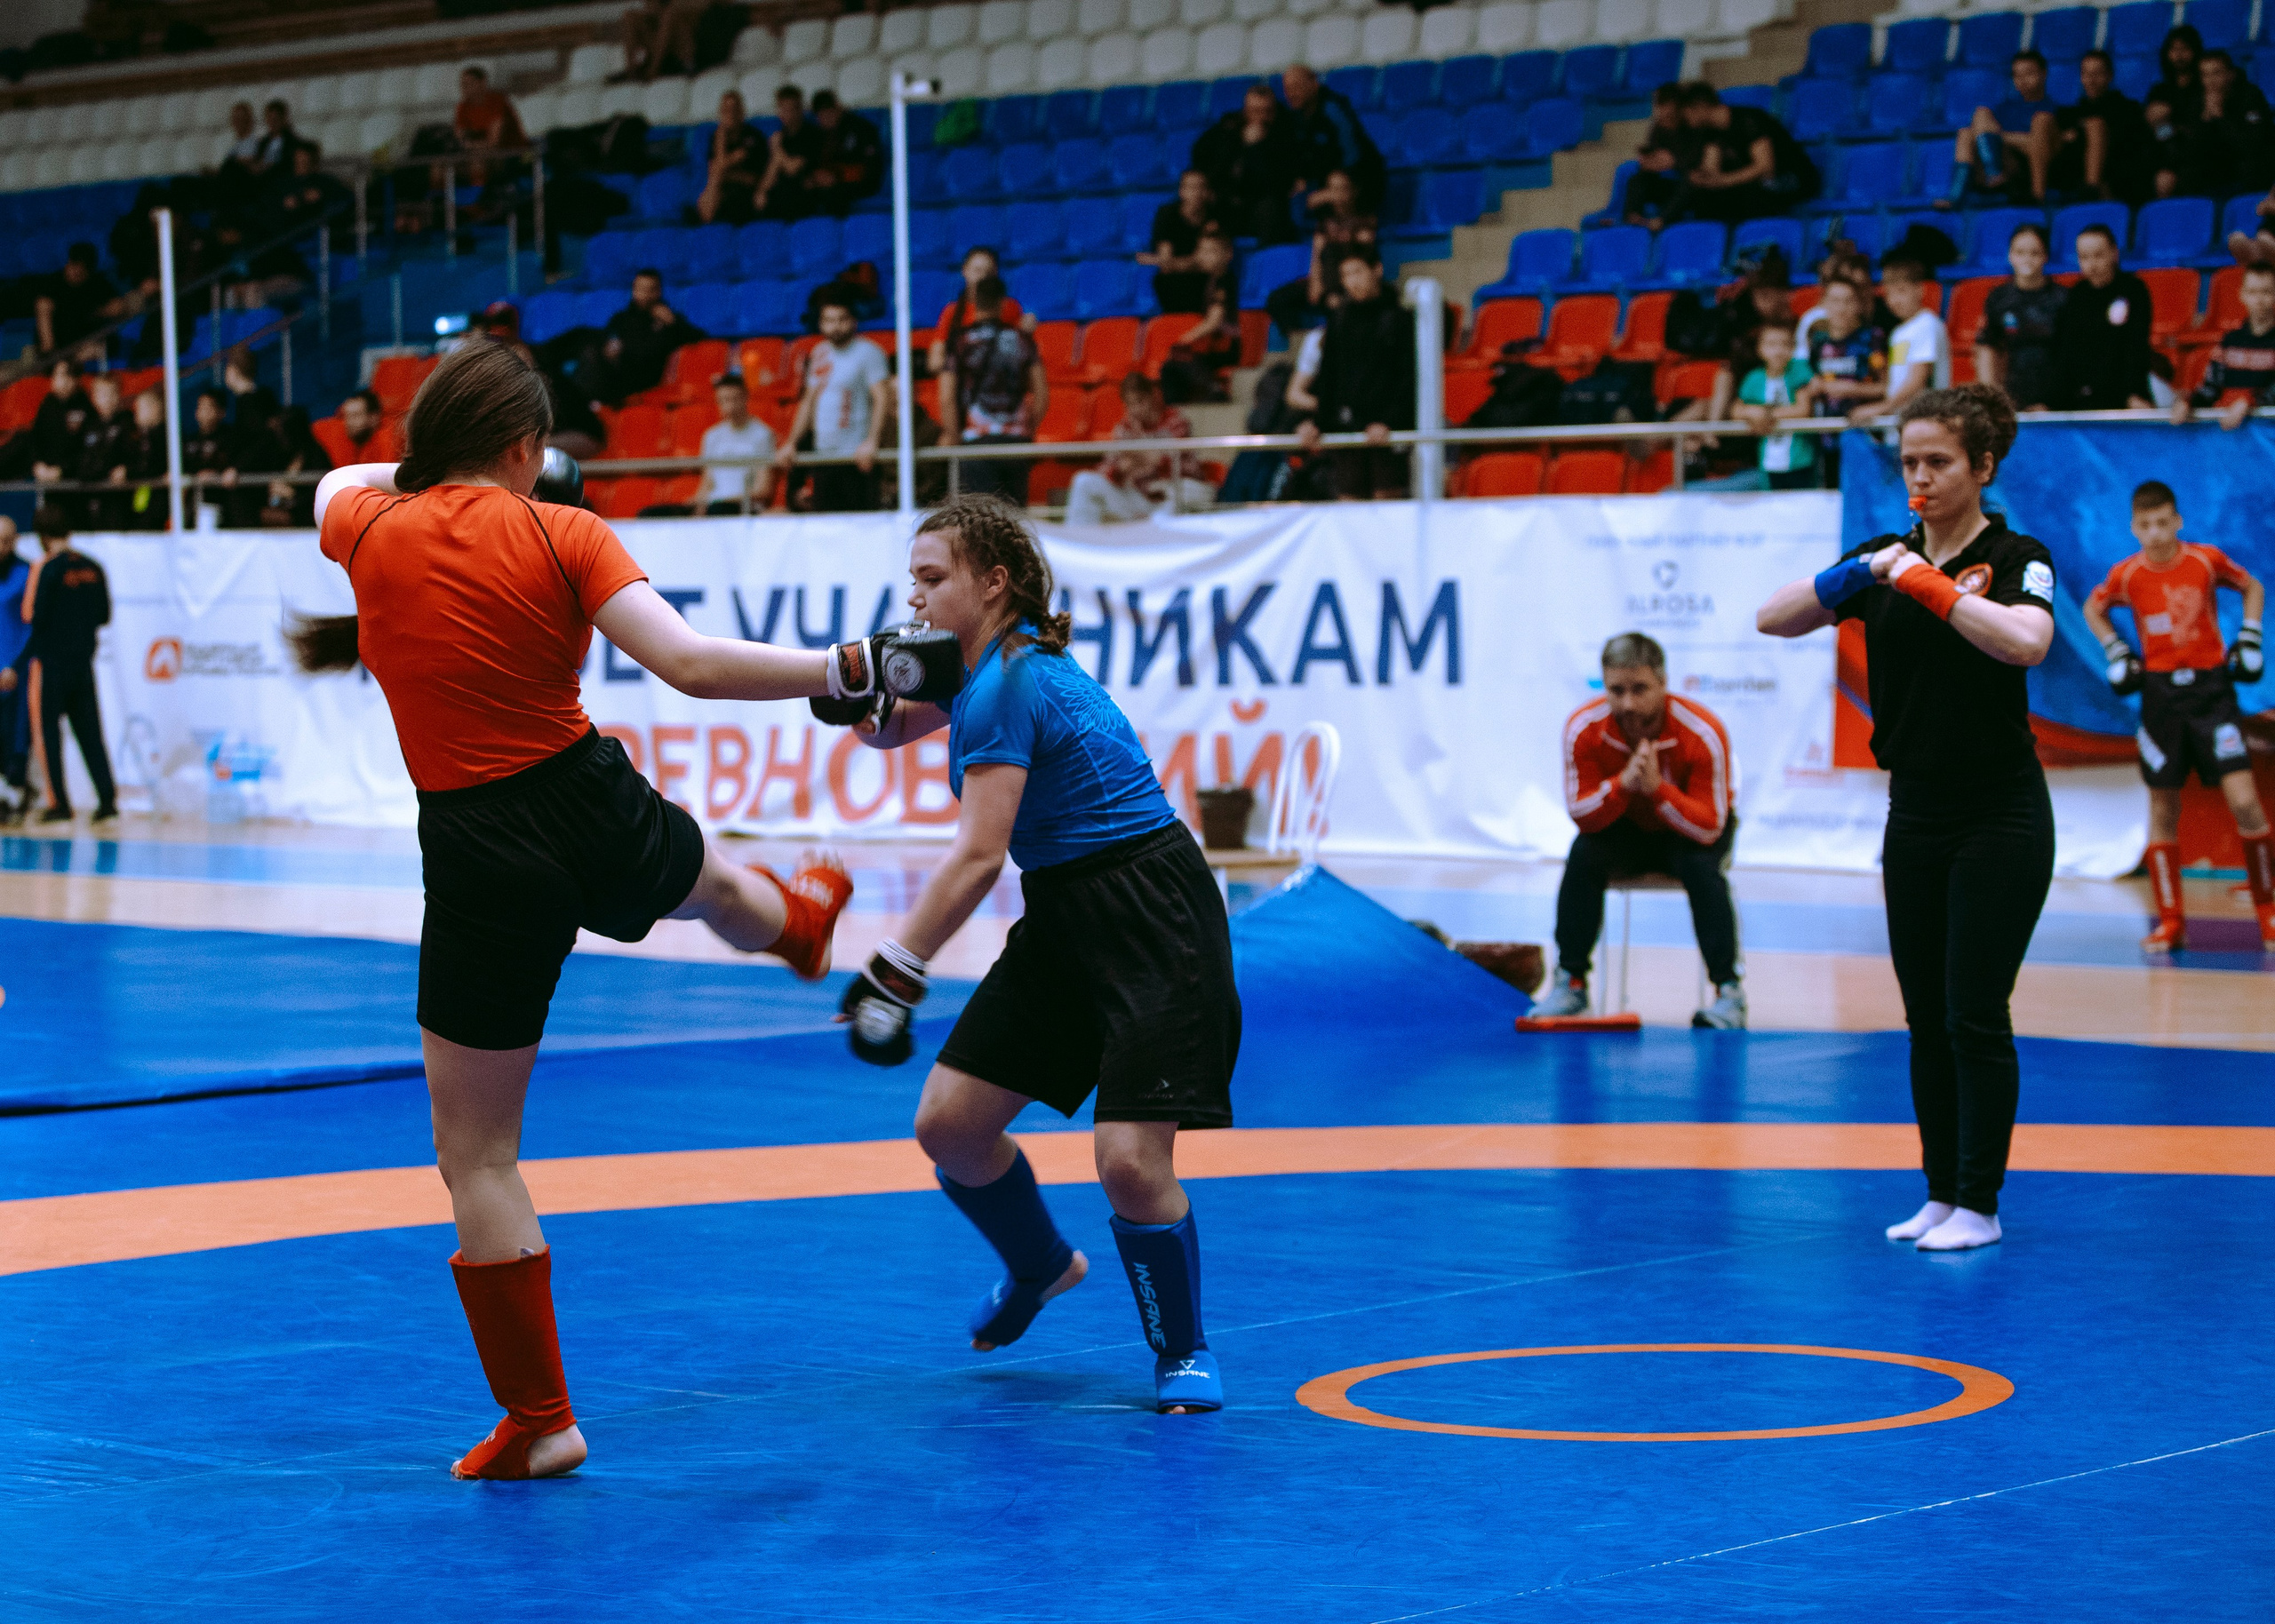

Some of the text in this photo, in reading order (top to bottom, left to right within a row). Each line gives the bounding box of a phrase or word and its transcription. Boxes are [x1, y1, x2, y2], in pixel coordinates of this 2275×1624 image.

[731, 580, 1462, 688] УЧНИКАМ
[1133, 1262, 1167, 1349] INSANE
[1165, 1370, 1211, 1379] INSANE
